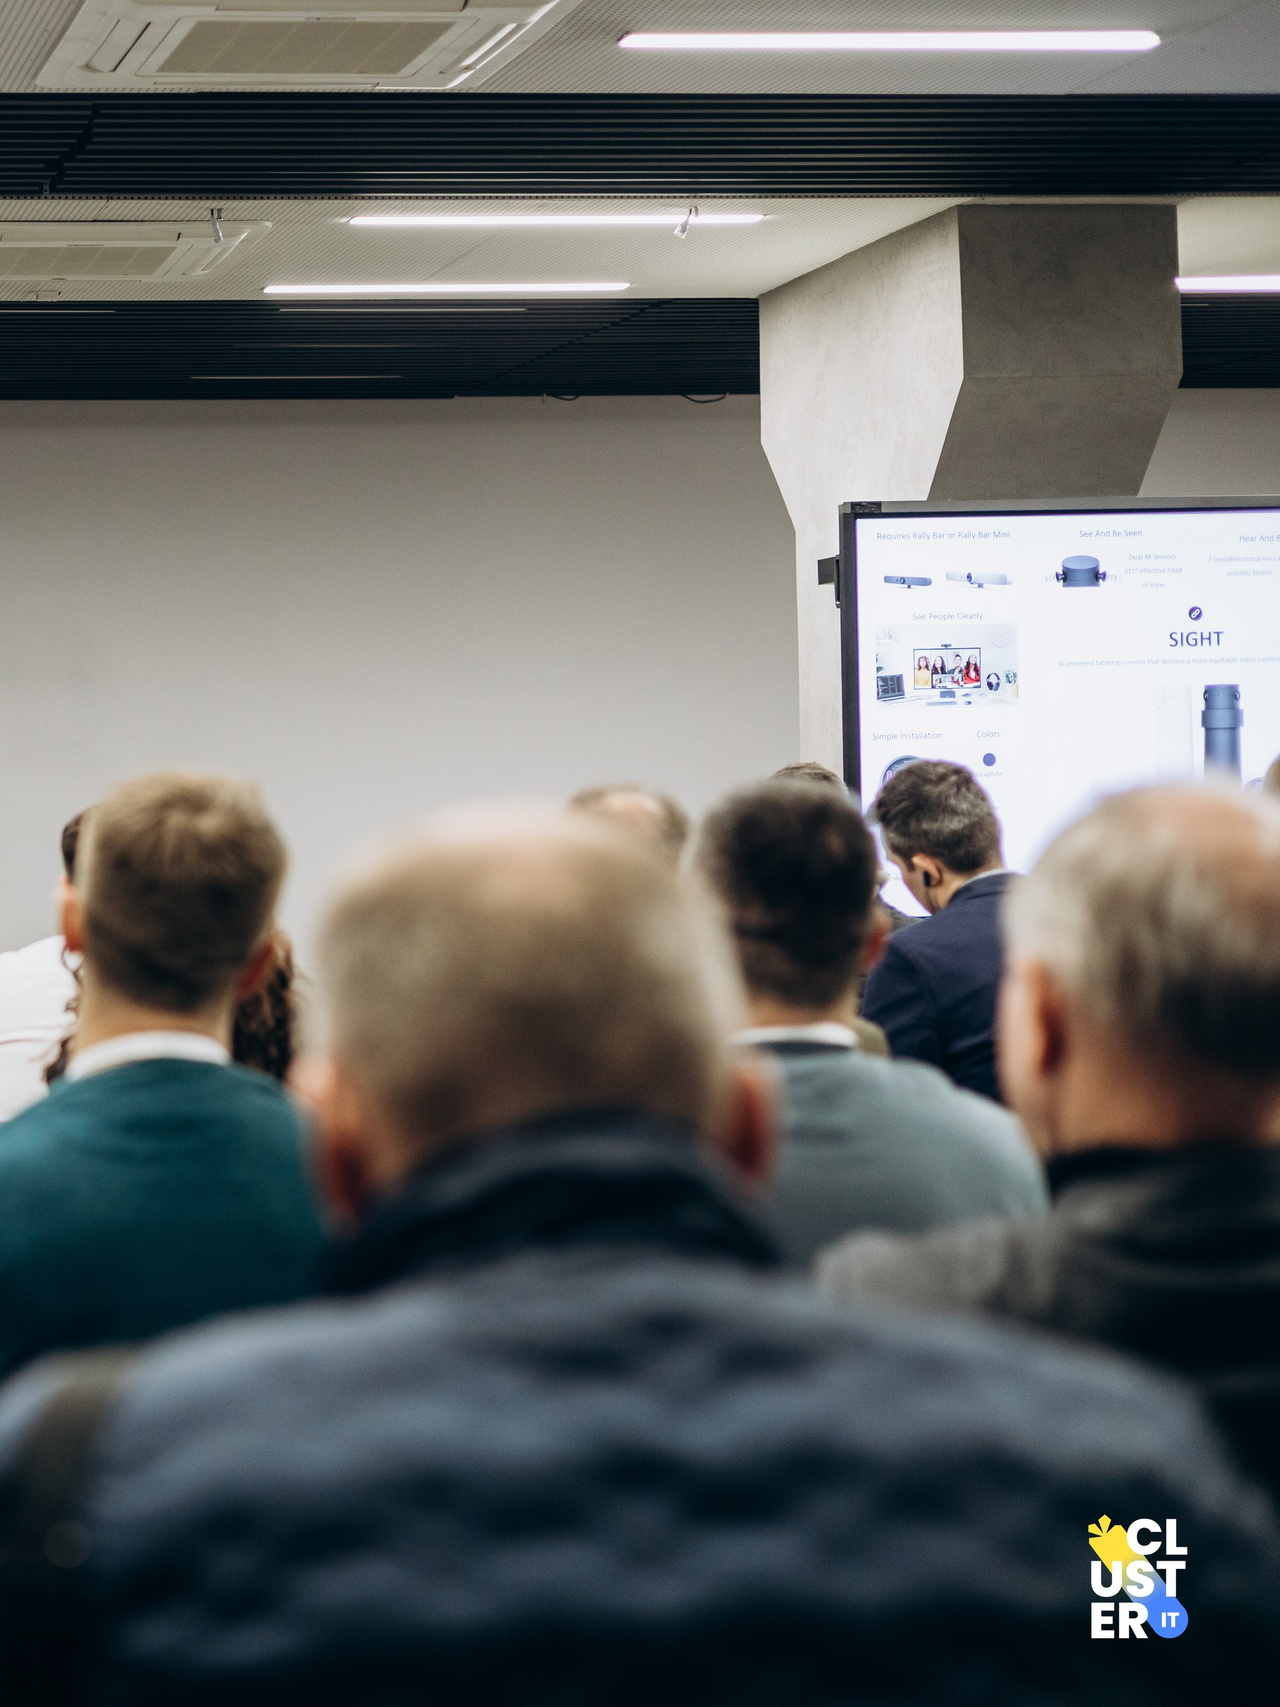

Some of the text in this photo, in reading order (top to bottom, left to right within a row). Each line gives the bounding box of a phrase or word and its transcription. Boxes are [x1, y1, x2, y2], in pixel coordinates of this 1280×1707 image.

[877, 532, 910, 541] Requires
[912, 532, 931, 541] Rally
[933, 532, 945, 540] Bar
[958, 531, 976, 540] Rally
[978, 531, 991, 539] Bar
[993, 531, 1011, 539] Mini
[1124, 529, 1143, 537] Seen
[1239, 534, 1258, 542] Hear
[1259, 534, 1275, 542] And
[1167, 566, 1182, 574] Field
[912, 611, 983, 621] See People Clearly
[1169, 631, 1224, 647] SIGHT
[1096, 659, 1122, 667] tabletop
[1209, 657, 1238, 665] equitable
[872, 731, 943, 741] Simple Installation
[976, 730, 1000, 738] Colors
